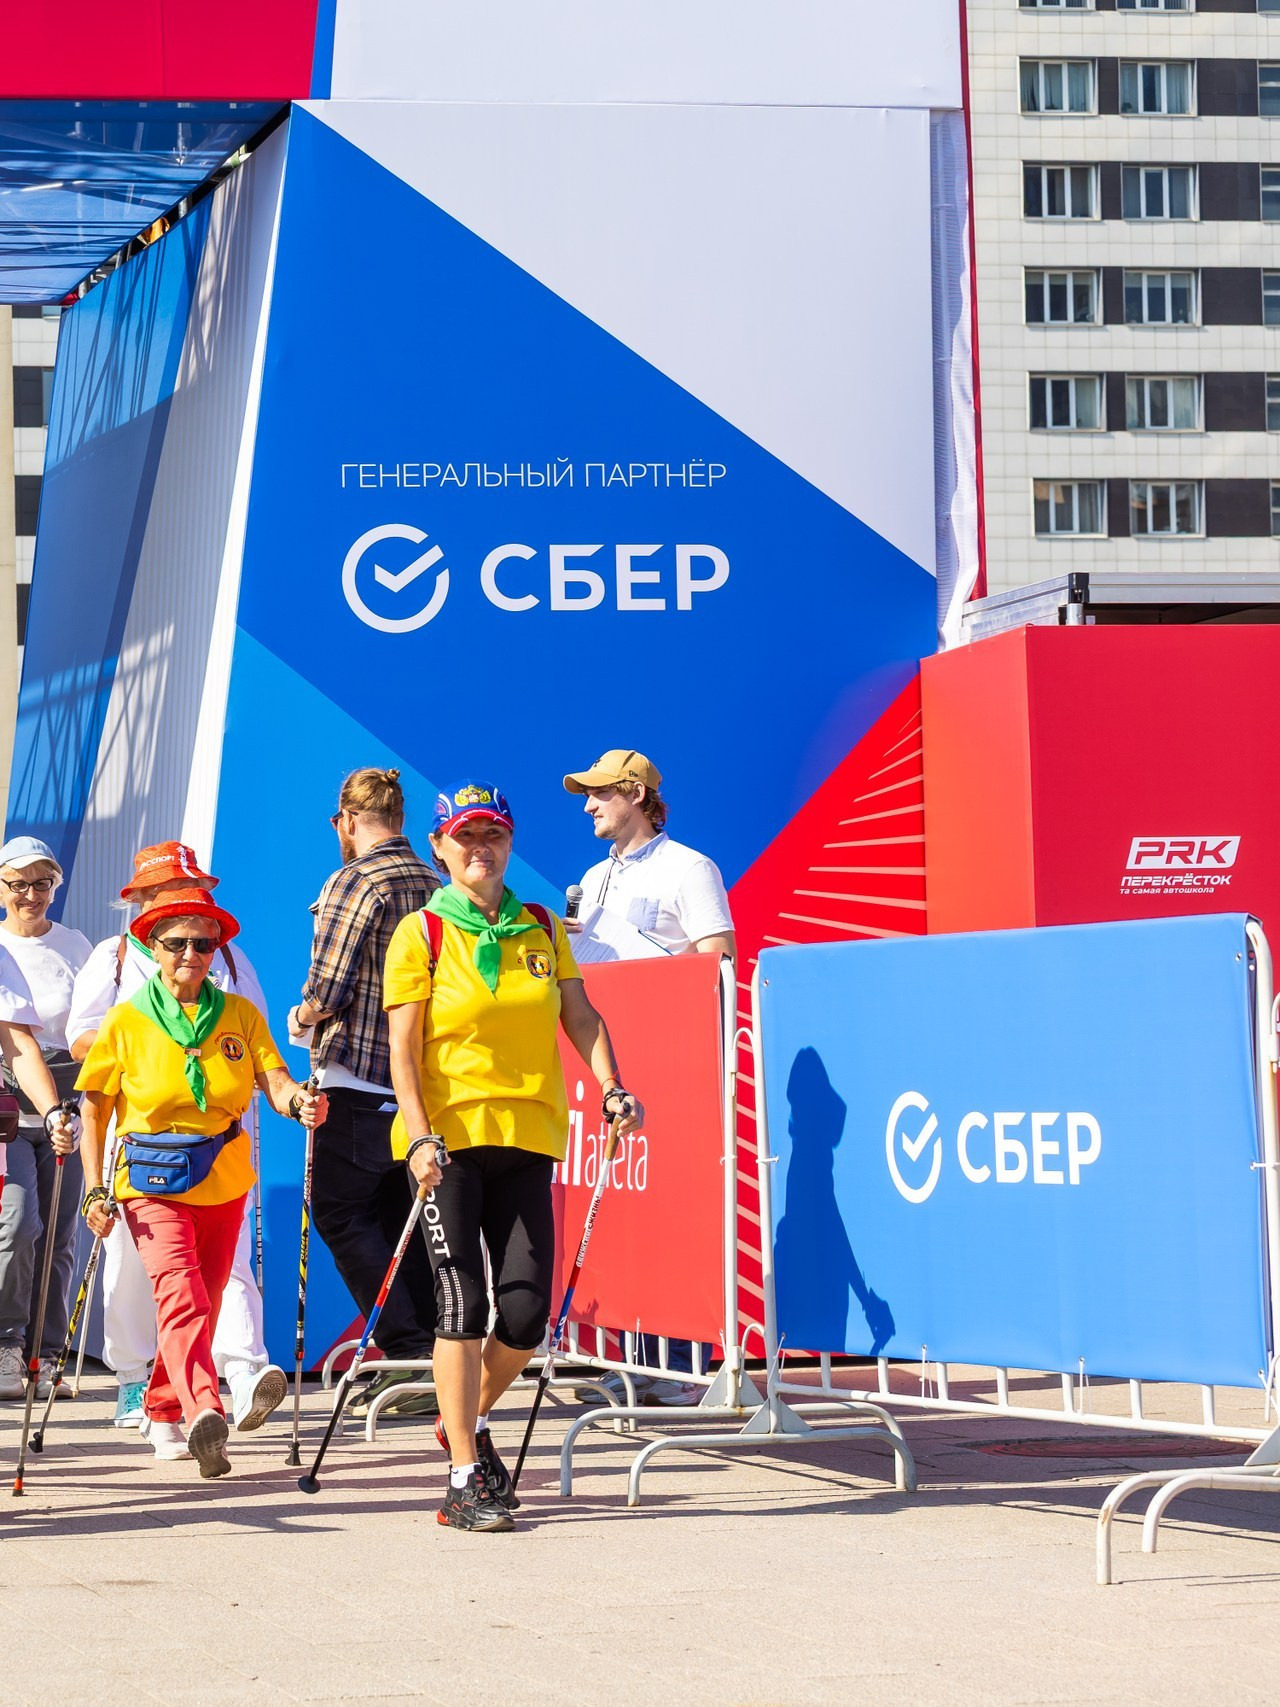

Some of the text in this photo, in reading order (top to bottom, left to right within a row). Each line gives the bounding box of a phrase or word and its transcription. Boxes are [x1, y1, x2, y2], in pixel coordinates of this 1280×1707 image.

[341, 457, 727, 488] ГЕНЕРАЛЬНЫЙ ПАРТНЁР
[480, 543, 730, 612] СБЕР
[1134, 840, 1232, 865] PRK
[1120, 873, 1232, 887] ПЕРЕКРЁСТОК
[957, 1111, 1102, 1185] СБЕР
